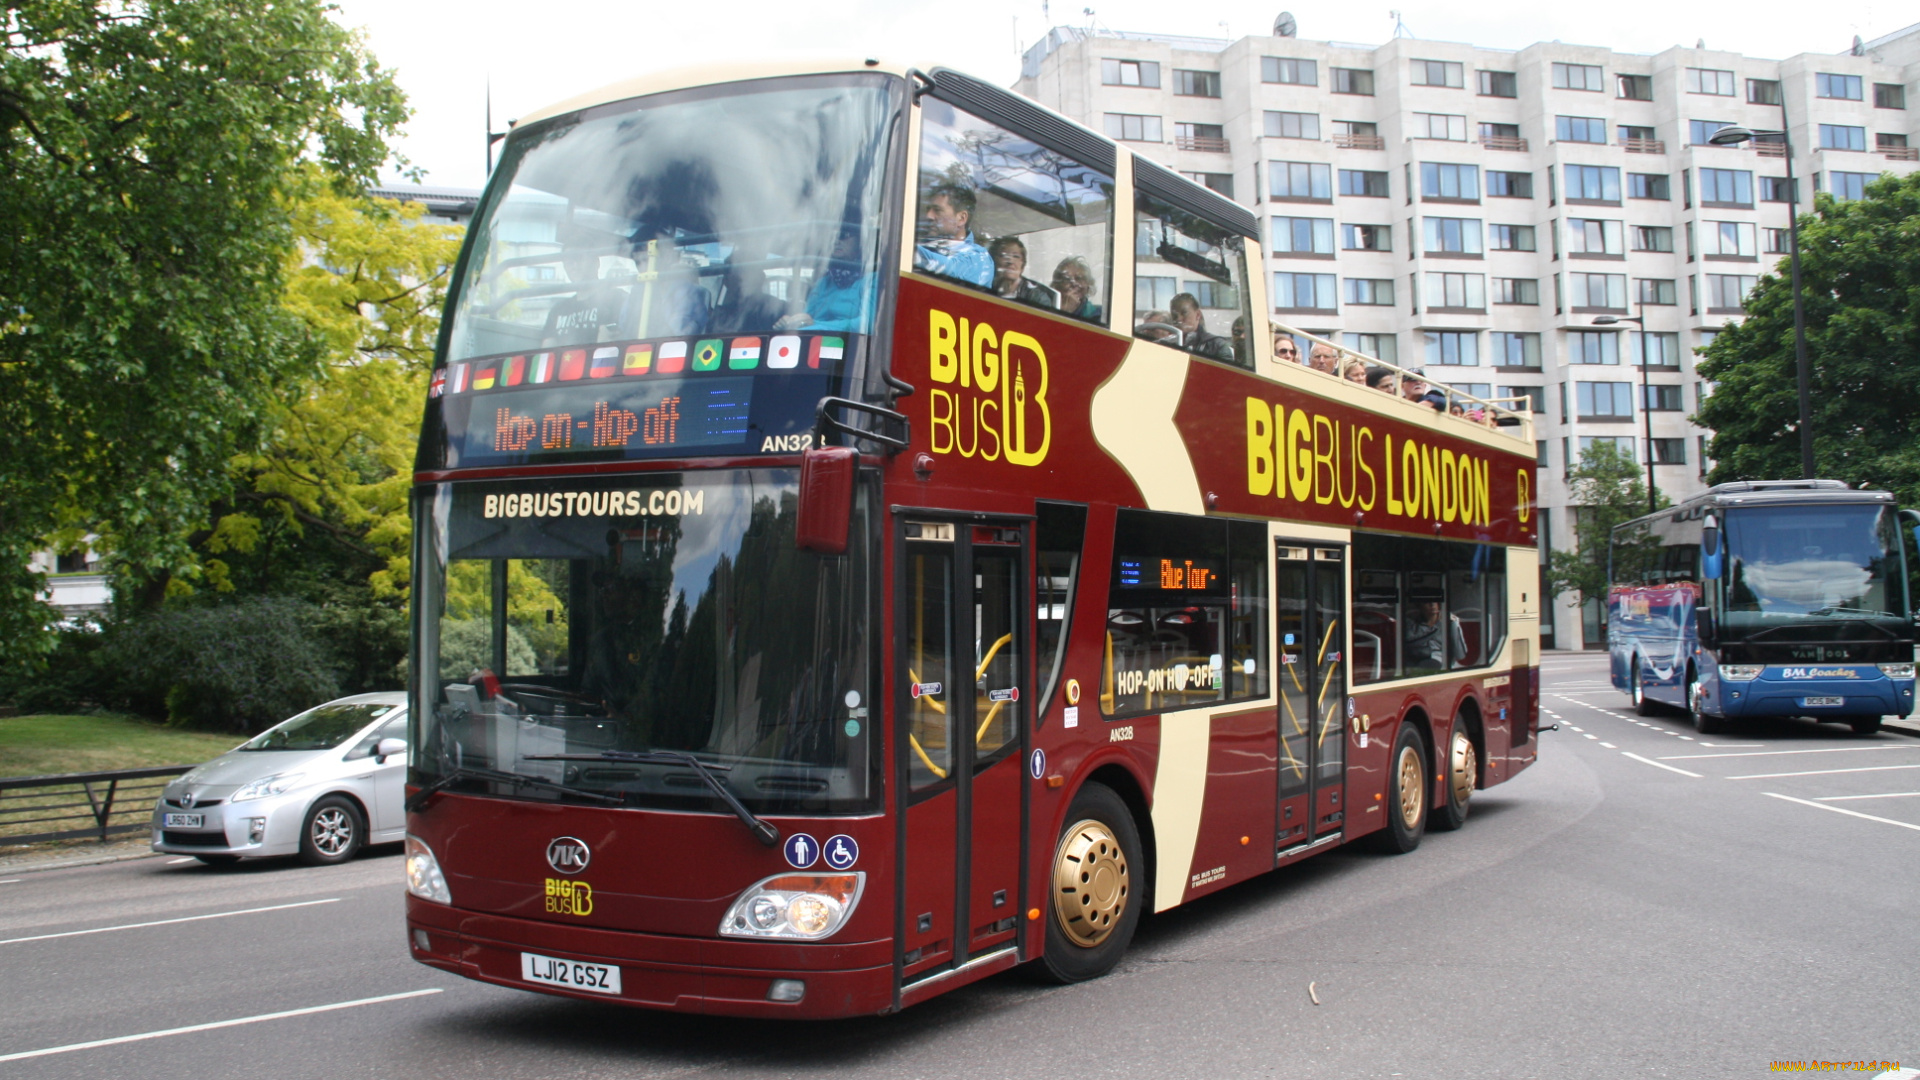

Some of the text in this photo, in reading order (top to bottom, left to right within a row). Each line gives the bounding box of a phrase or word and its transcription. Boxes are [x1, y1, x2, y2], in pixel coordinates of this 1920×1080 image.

[930, 308, 999, 393] BIG
[495, 407, 537, 451] Hop
[541, 413, 571, 449] on
[593, 401, 638, 446] Hop
[643, 396, 680, 444] off
[930, 388, 1000, 461] BUS
[1386, 433, 1491, 527] LONDON
[484, 490, 704, 519] BIGBUSTOURS.COM
[1161, 559, 1183, 589] Blue
[1185, 560, 1209, 589] Tour
[1118, 665, 1214, 695] HOP-ON HOP-OFF
[1782, 668, 1858, 679] BM Coaches
[1110, 726, 1133, 742] AN328
[545, 878, 571, 897] BIG
[546, 896, 572, 914] BUS
[532, 957, 609, 988] LJ12 GSZ
